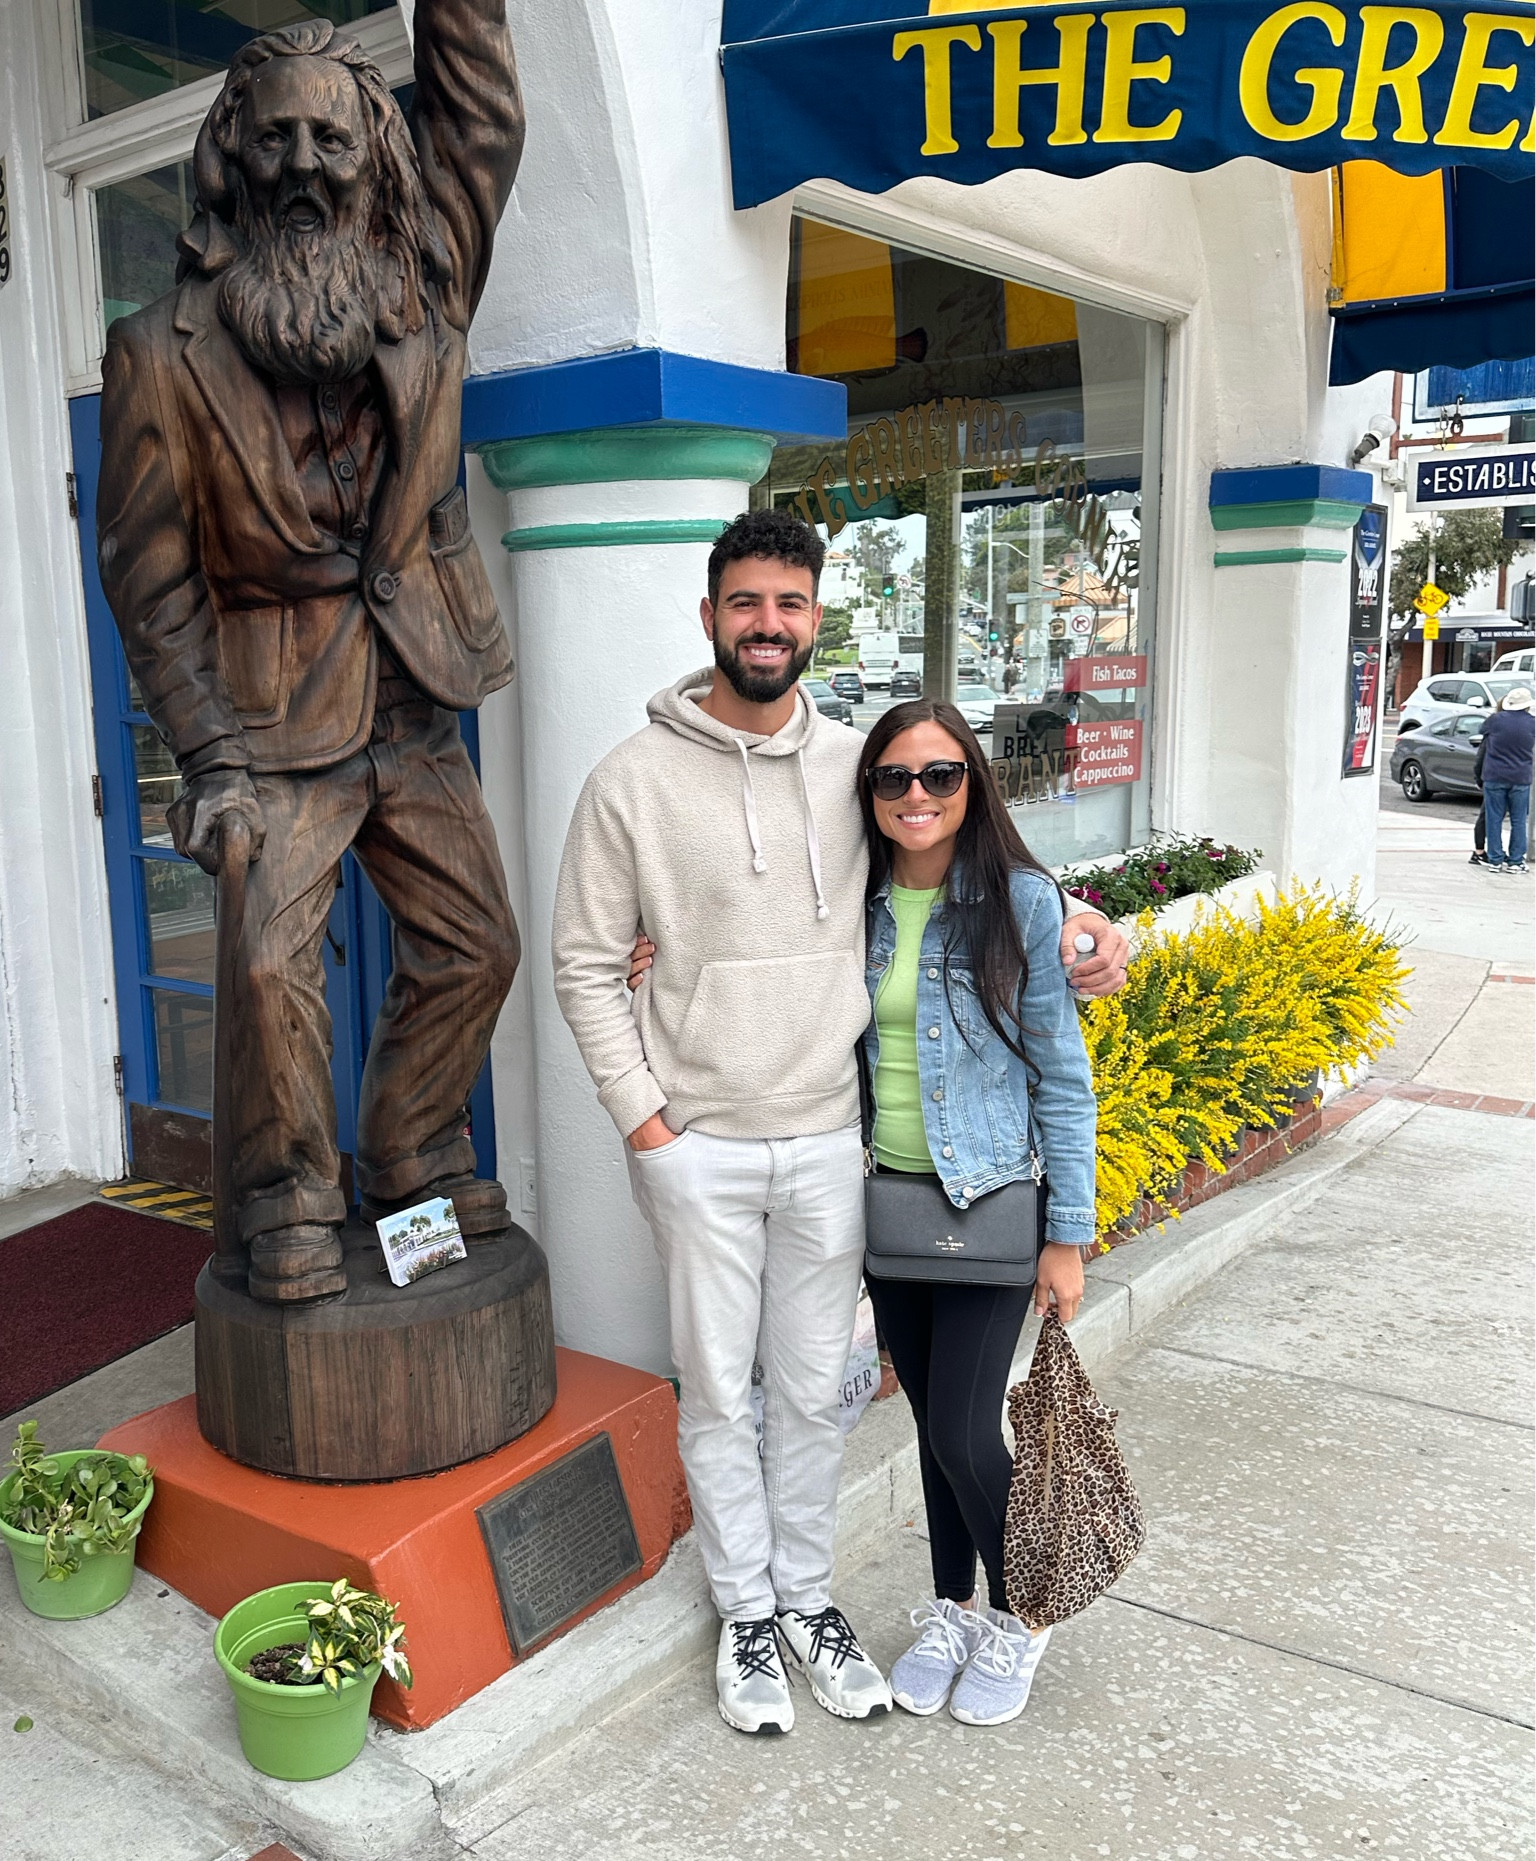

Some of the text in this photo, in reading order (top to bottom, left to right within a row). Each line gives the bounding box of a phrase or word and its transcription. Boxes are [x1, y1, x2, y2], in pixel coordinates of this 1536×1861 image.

[892, 0, 1535, 157] THE GRE
[846, 396, 1027, 510] GREETERS
[1092, 664, 1137, 682] Fish Tacos
[1076, 725, 1134, 744] Beer Wine
[1080, 743, 1129, 763] Cocktails
[1073, 762, 1134, 785] Cappuccino
[838, 1369, 873, 1408] GER
